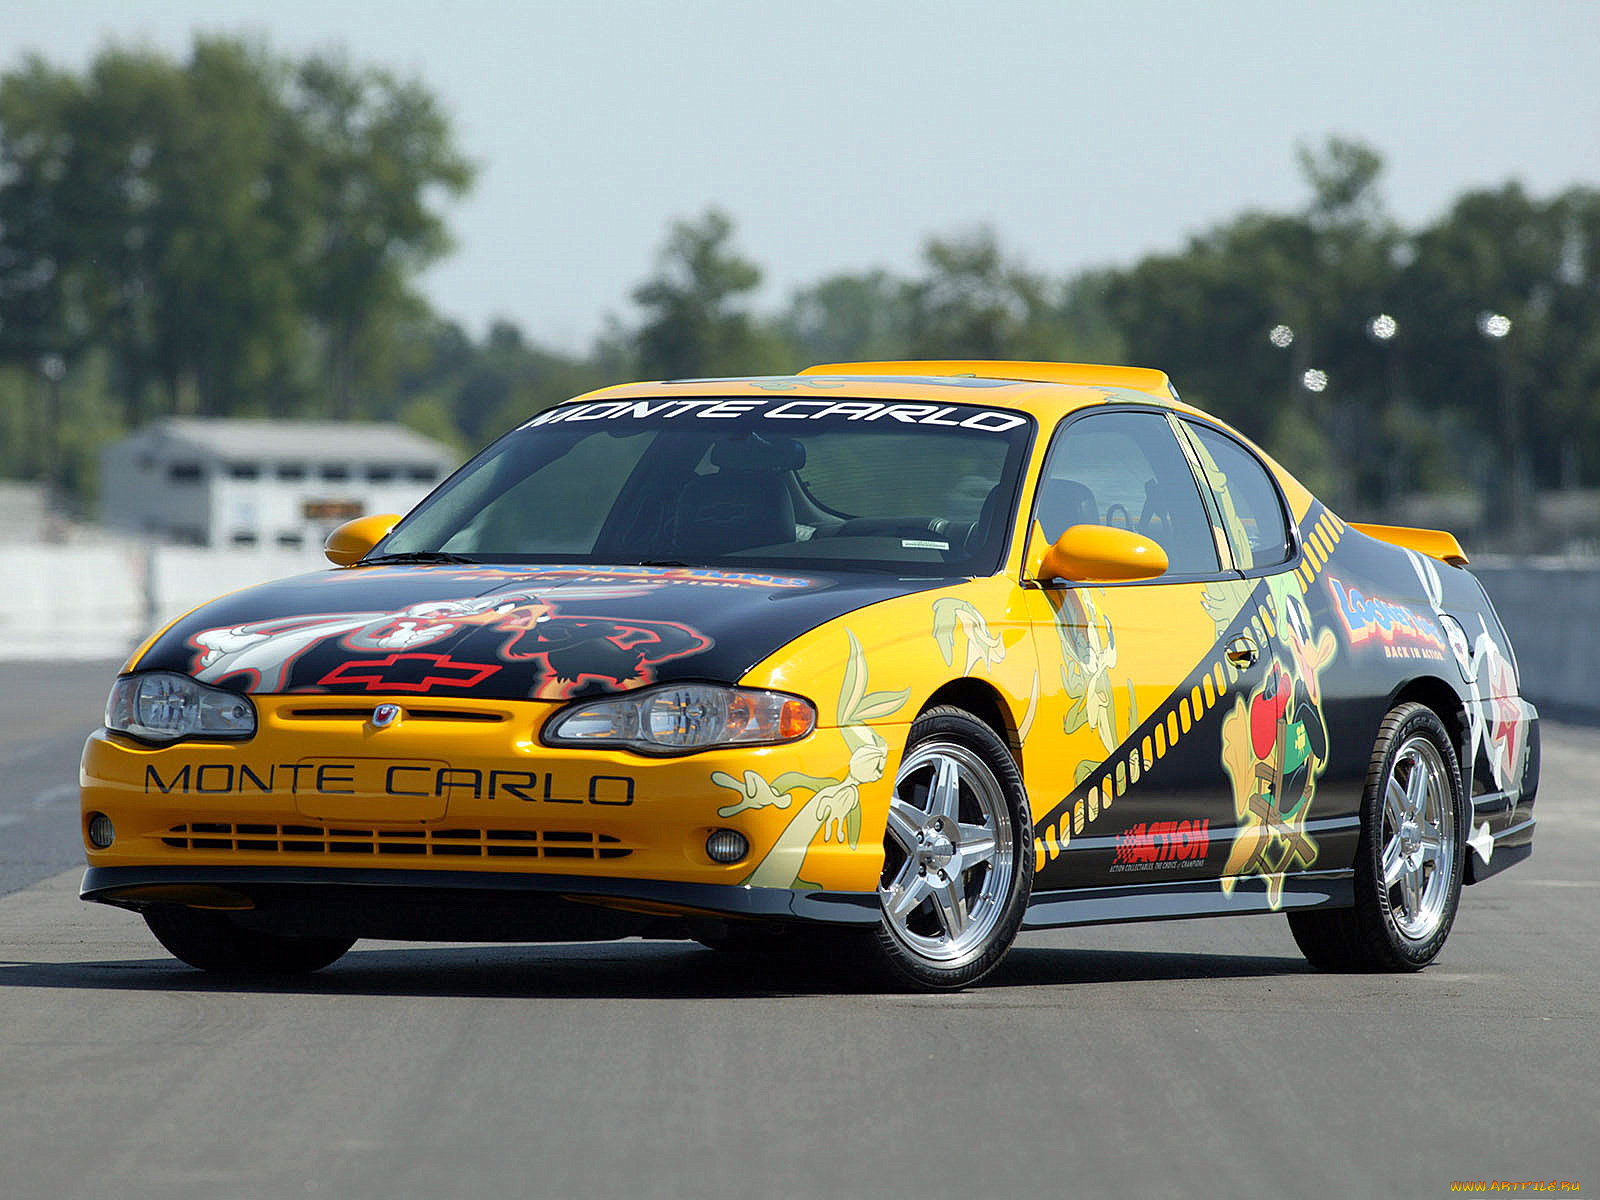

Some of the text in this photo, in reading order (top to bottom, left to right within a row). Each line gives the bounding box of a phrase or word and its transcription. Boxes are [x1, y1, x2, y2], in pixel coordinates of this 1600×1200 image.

[515, 400, 1027, 433] MONTE CARLO
[1384, 646, 1410, 659] BACK
[1410, 647, 1421, 658] IN
[145, 763, 635, 807] MONTE CARLO
[1120, 818, 1210, 864] ACTION
